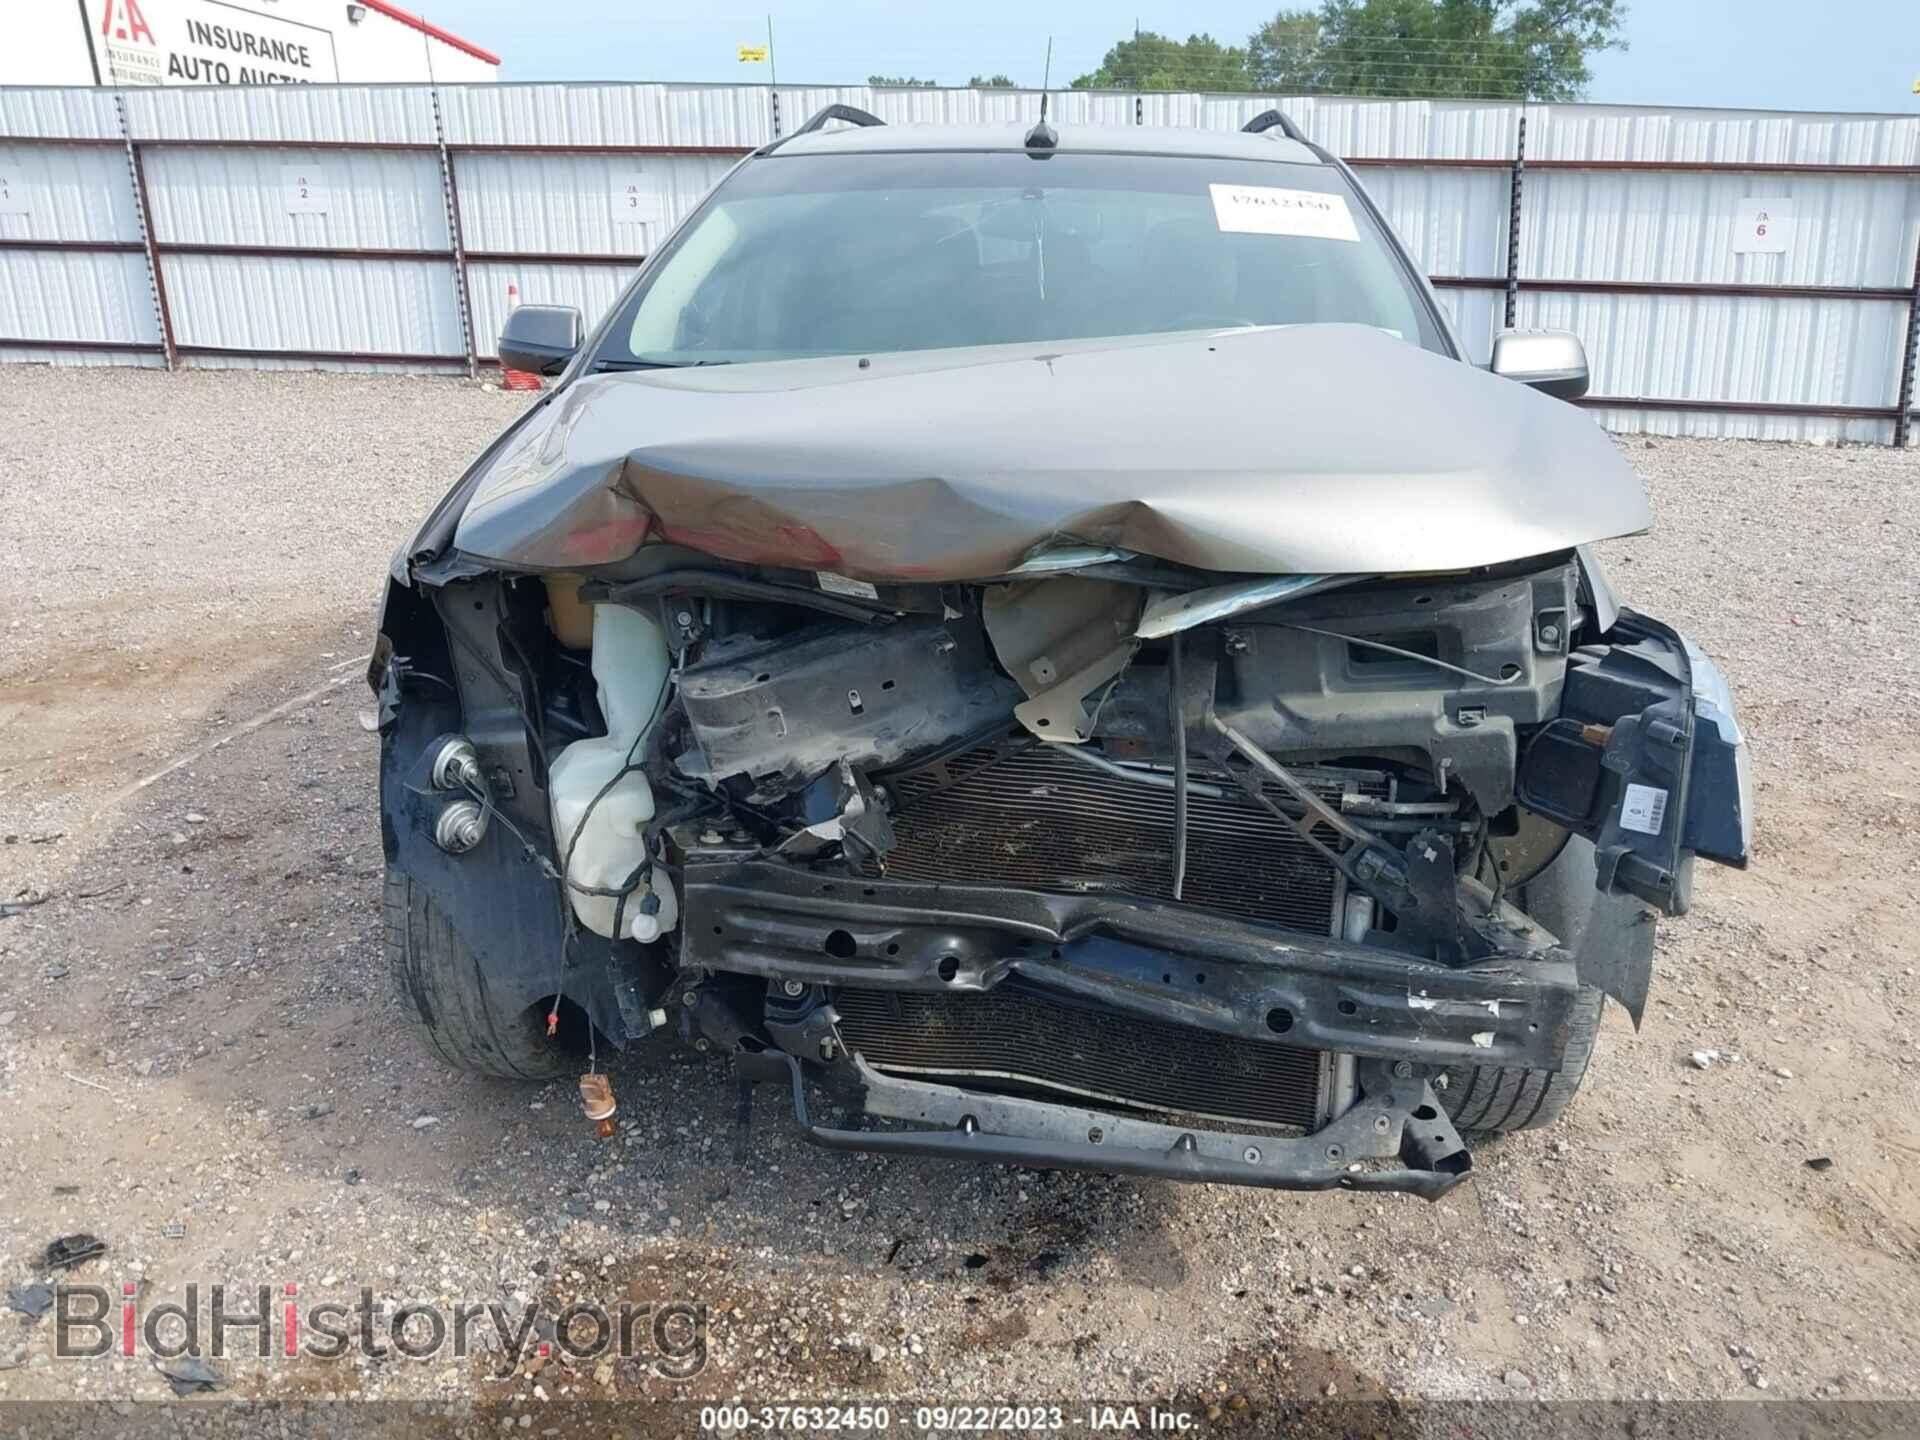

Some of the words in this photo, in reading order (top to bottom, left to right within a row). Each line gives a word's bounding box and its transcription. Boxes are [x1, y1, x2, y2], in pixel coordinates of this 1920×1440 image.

[186, 19, 311, 67] INSURANCE
[167, 52, 230, 84] AUTO
[300, 188, 309, 199] 2
[629, 197, 638, 208] 3
[1756, 224, 1767, 237] 6
